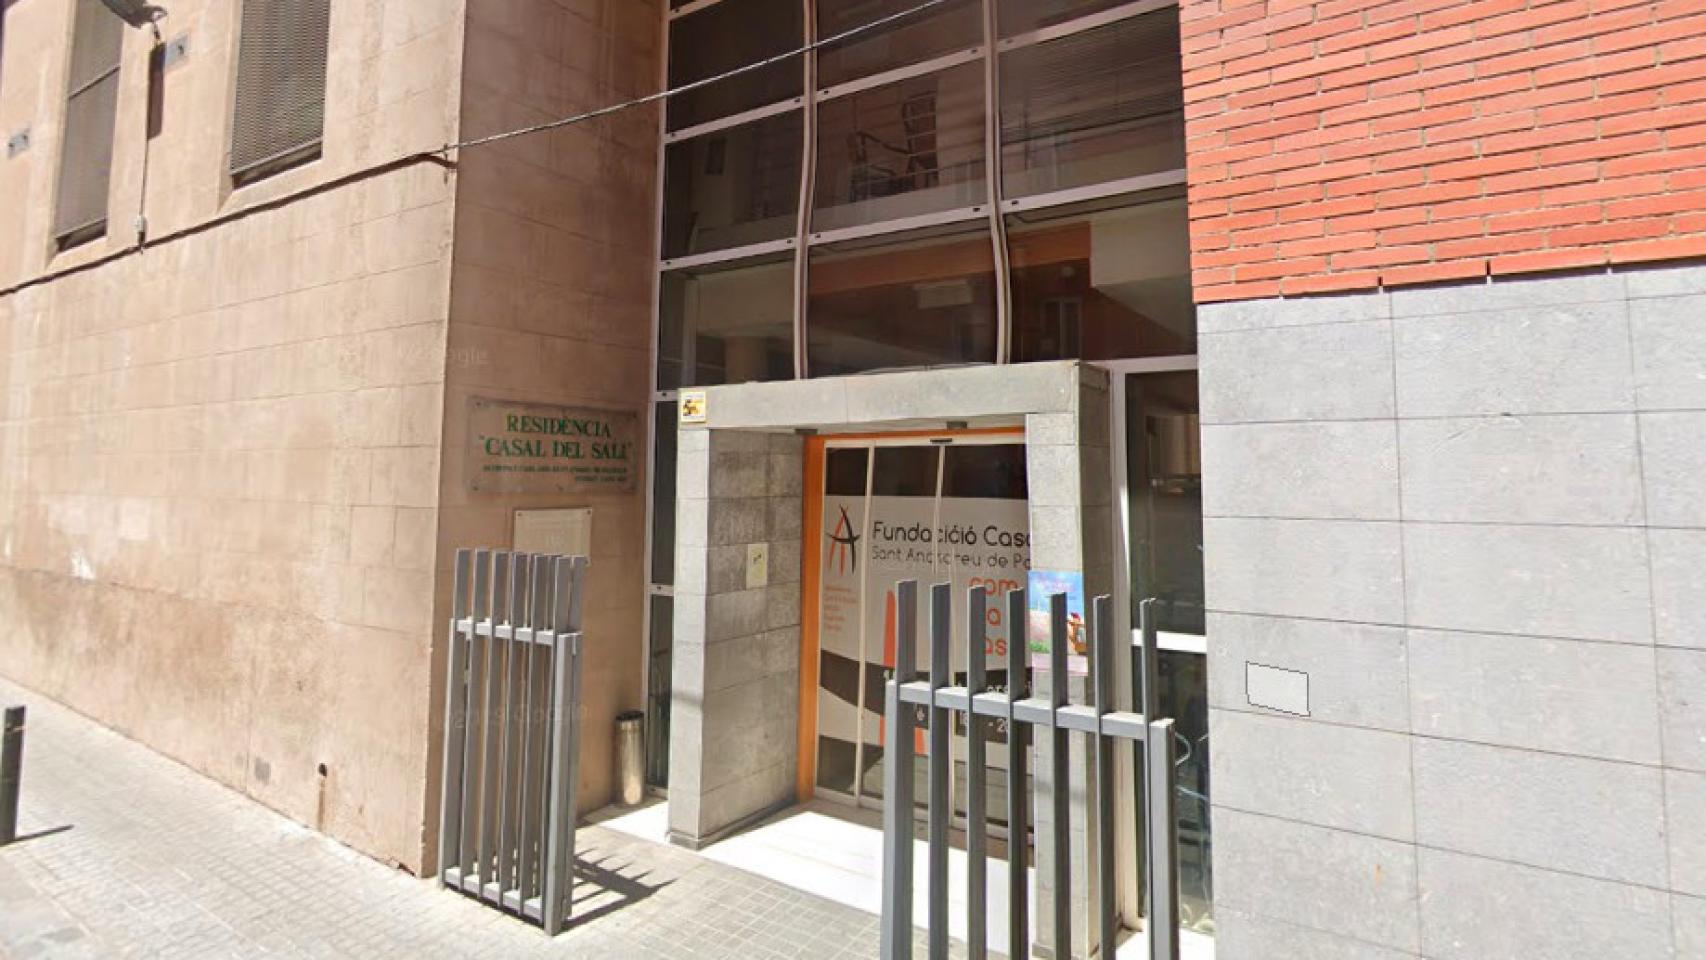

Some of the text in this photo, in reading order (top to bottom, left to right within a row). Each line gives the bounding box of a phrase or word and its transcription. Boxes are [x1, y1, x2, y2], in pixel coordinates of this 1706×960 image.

[553, 440, 584, 459] DEL
[872, 546, 901, 560] Sant
[987, 552, 1009, 568] de
